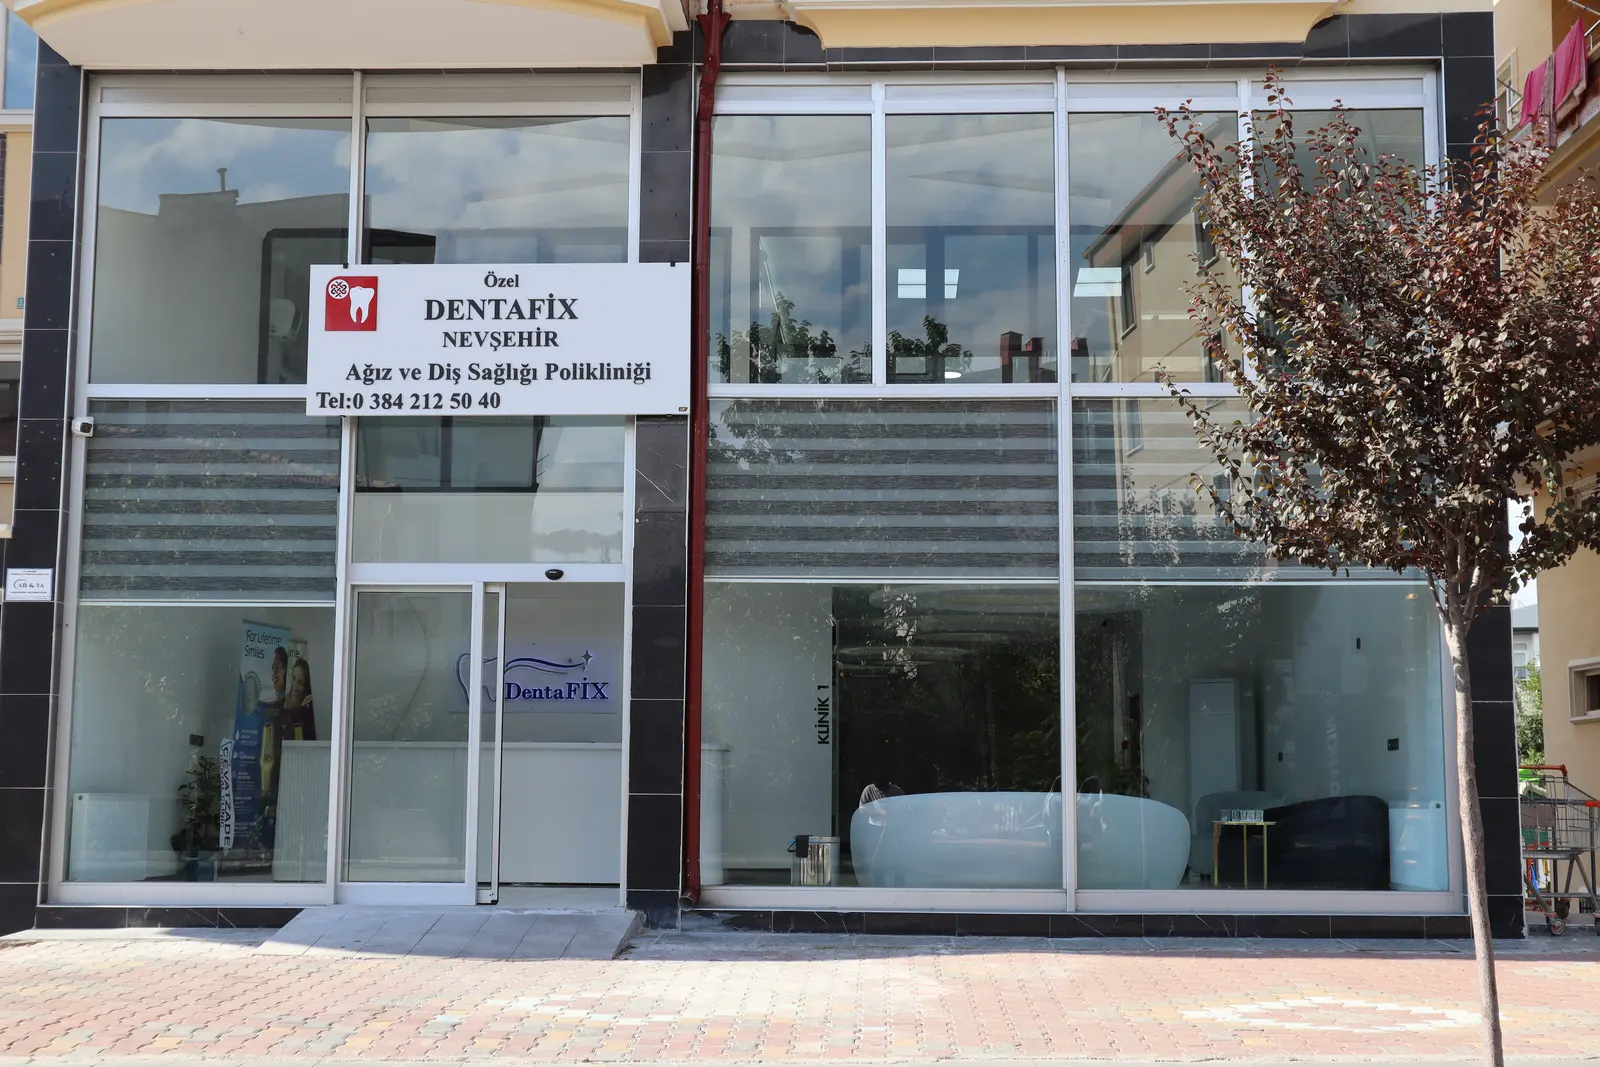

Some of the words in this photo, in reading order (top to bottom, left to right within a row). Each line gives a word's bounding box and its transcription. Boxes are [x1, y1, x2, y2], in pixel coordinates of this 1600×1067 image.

[483, 270, 520, 288] Özel
[423, 292, 579, 321] DENTAFİX
[441, 326, 560, 352] NEVŞEHİR
[345, 363, 393, 386] Ağız
[398, 367, 422, 381] ve
[427, 362, 462, 386] Diş
[467, 362, 539, 386] Sağlığı
[544, 361, 652, 385] Polikliniği
[368, 392, 404, 410] 384
[409, 392, 444, 410] 212
[449, 392, 473, 410] 50
[477, 391, 501, 409] 40
[246, 630, 257, 642] For
[257, 631, 282, 646] Lifetime
[244, 645, 264, 659] Smiles
[505, 677, 608, 699] DentaFİX
[814, 697, 829, 744] KLİNİK
[223, 747, 231, 847] CEVATZADE
